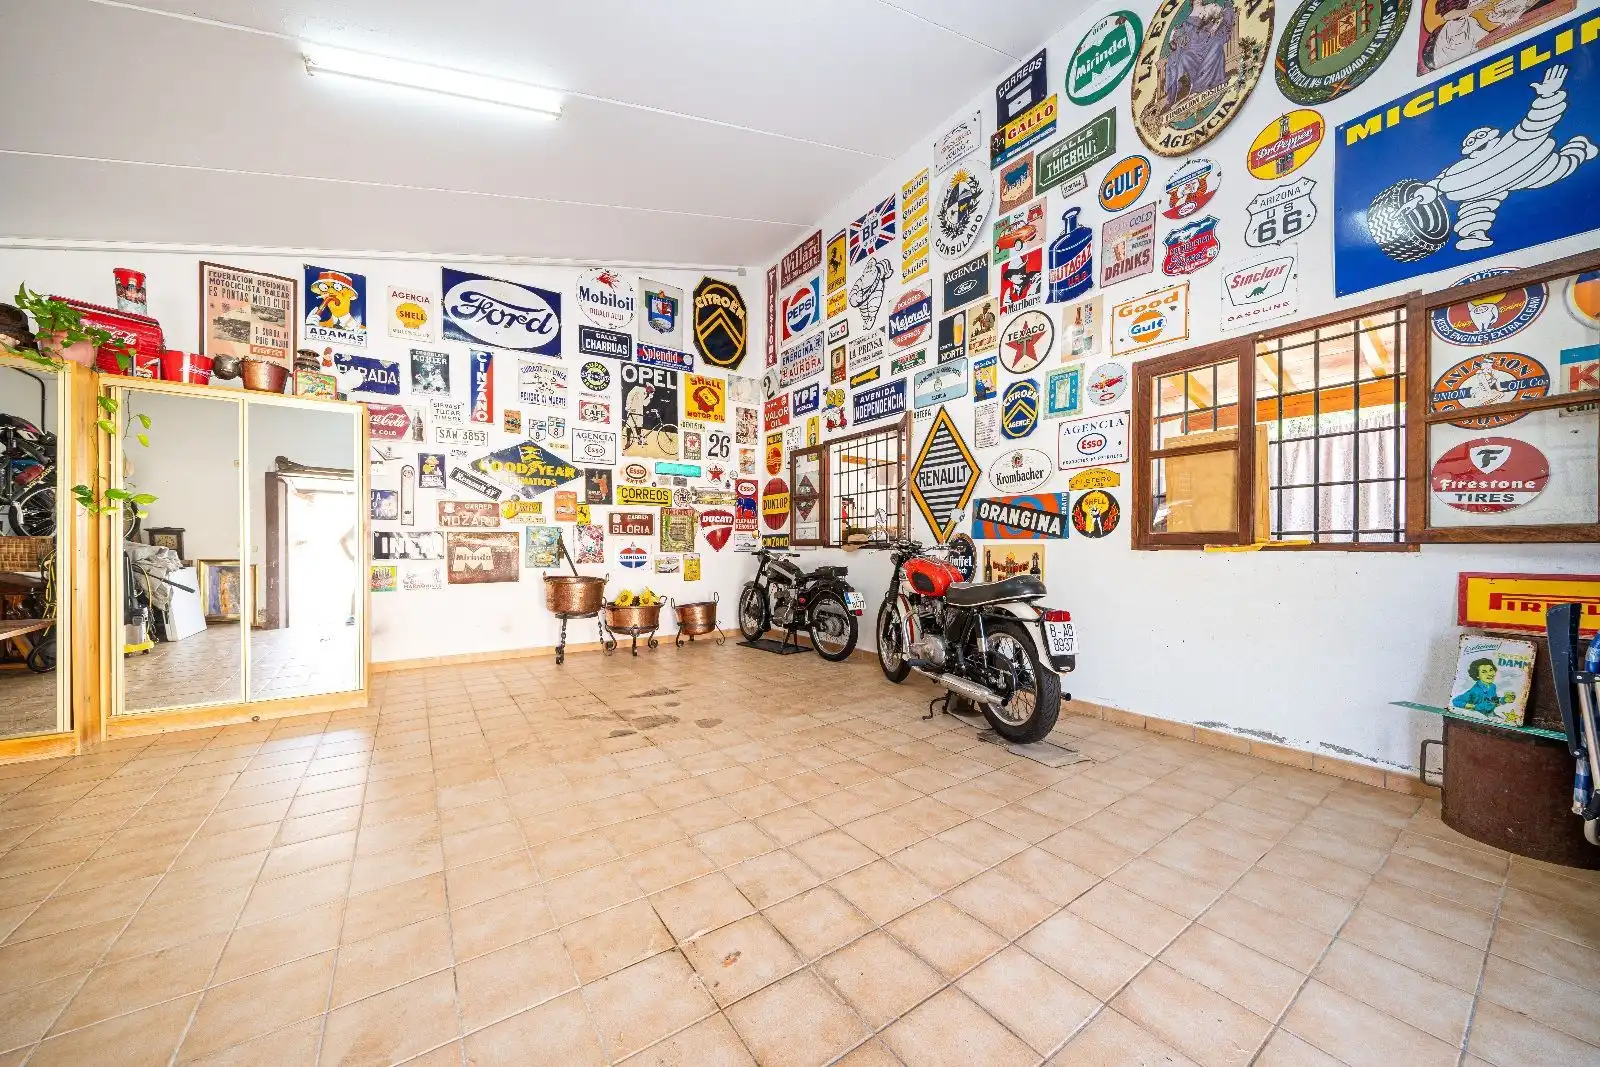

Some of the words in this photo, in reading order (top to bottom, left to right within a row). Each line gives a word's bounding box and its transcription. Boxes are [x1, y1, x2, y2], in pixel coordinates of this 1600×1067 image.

[1076, 35, 1128, 81] Mirinda
[998, 57, 1043, 99] CORREOS
[1007, 104, 1054, 140] GALLO
[1159, 99, 1239, 149] AGENCIA
[1052, 128, 1094, 158] CALLE
[1102, 165, 1145, 198] GULF
[1259, 186, 1302, 208] ARIZONA
[862, 218, 879, 242] BP
[1129, 211, 1153, 228] COLD
[1257, 209, 1303, 244] 66
[935, 214, 984, 256] CONSULADO
[783, 233, 821, 276] Willard
[1050, 244, 1093, 284] BUTAGAZ
[1104, 248, 1151, 282] DRINKS
[945, 257, 988, 284] AGENCIA
[1231, 263, 1289, 290] Sinclair
[391, 289, 431, 305] AGENCIA
[578, 285, 635, 312] Mobiloil
[1007, 295, 1042, 316] Marlboro
[1118, 291, 1180, 318] Good
[399, 308, 427, 322] SHELL
[450, 290, 554, 335] Ford
[787, 295, 815, 323] PEPSI
[891, 302, 932, 334] Mejoral
[1227, 300, 1291, 323] GASOLINE
[309, 327, 365, 344] ADAMAS
[595, 332, 618, 342] CALLE
[1007, 322, 1046, 341] TEXACO
[1130, 317, 1166, 335] Gulf
[1435, 318, 1451, 336] KEEPS
[1450, 331, 1489, 343] ENGINES
[1490, 321, 1523, 340] EXTRA
[642, 344, 679, 365] Splendid
[940, 346, 964, 361] NORTE
[475, 351, 489, 422] CINZANO
[621, 364, 677, 390] OPEL
[689, 375, 722, 391] SHELL
[793, 385, 818, 407] YPF
[859, 385, 897, 404] AVENIDA
[1433, 389, 1467, 402] UNION
[1508, 380, 1527, 391] OIL
[687, 410, 712, 420] MOTOR
[713, 413, 725, 422] OIL
[765, 406, 789, 423] VALOR
[770, 417, 783, 428] OIL
[575, 431, 614, 442] AGENCIA
[1063, 418, 1125, 436] AGENCIA
[707, 433, 731, 458] 26
[919, 464, 968, 488] RENAULT
[995, 468, 1045, 487] Krombacher
[1439, 477, 1537, 491] Firestone
[621, 487, 669, 501] CORREOS
[763, 495, 788, 511] DUNLOP
[1454, 492, 1516, 504] TIRES
[612, 524, 650, 534] GLORIA
[701, 515, 733, 524] DUCATI
[979, 502, 1062, 536] ORANGINA
[762, 537, 789, 549] CINZANO
